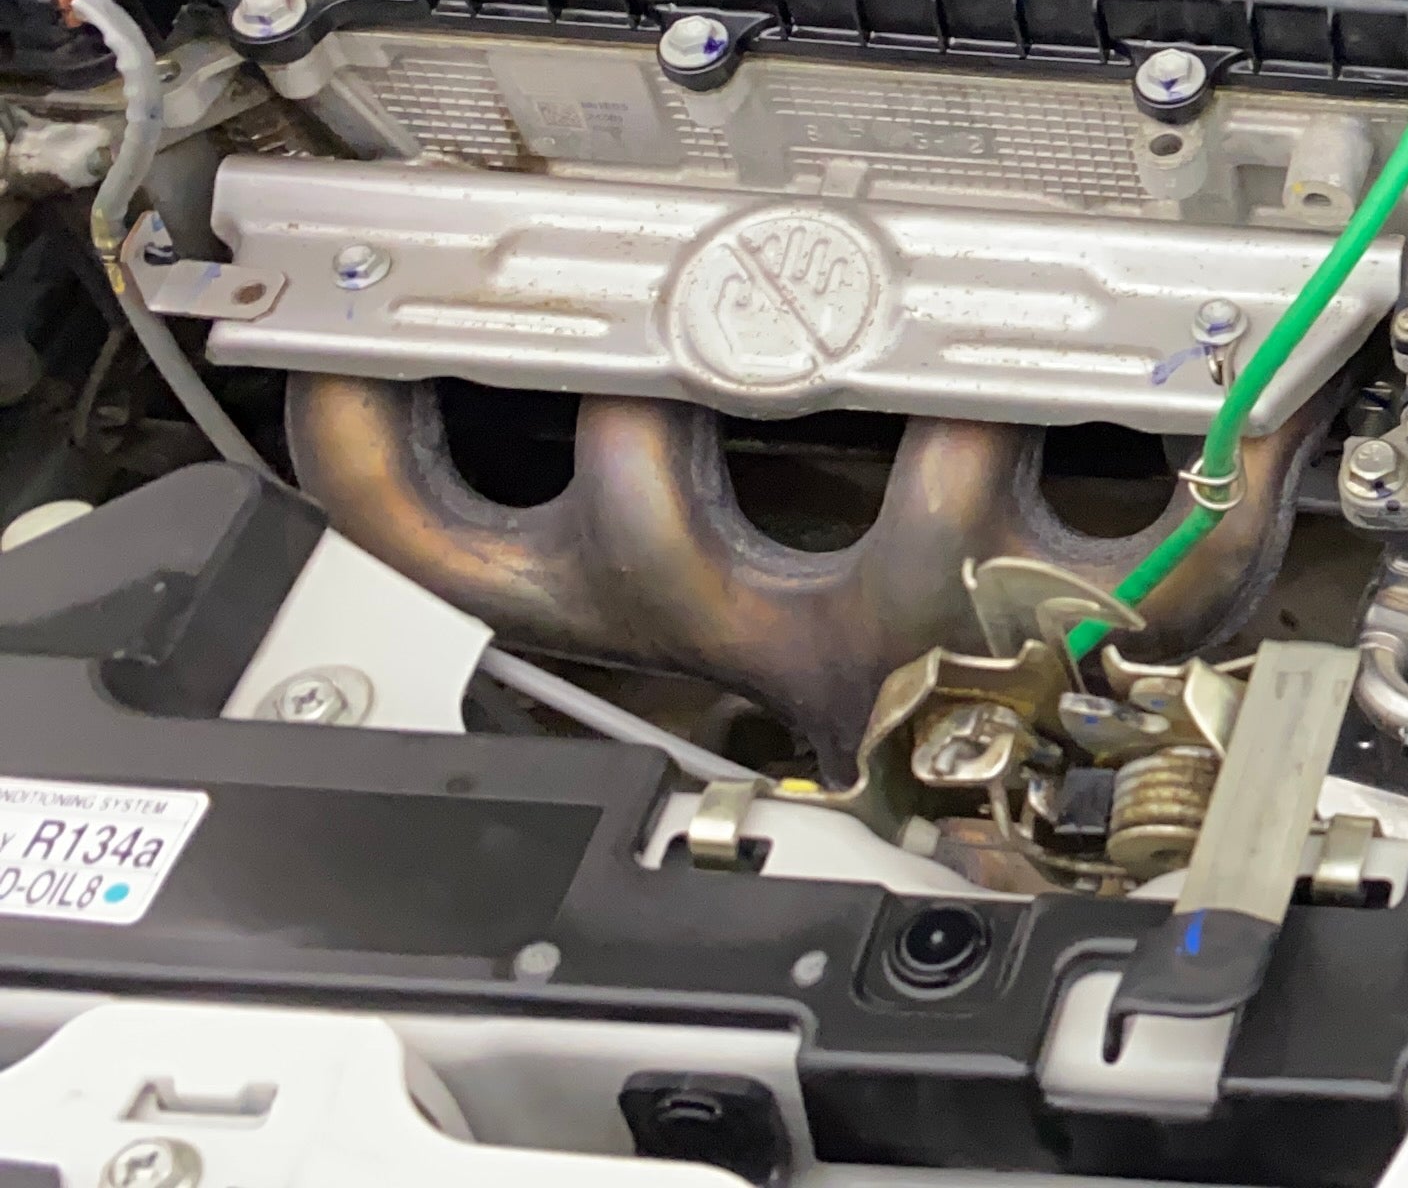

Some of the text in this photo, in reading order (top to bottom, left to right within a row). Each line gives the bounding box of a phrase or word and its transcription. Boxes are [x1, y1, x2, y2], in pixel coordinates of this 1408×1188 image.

[100, 797, 168, 815] SYSTEM
[22, 819, 165, 868] R134a
[0, 867, 104, 909] D-OIL8
